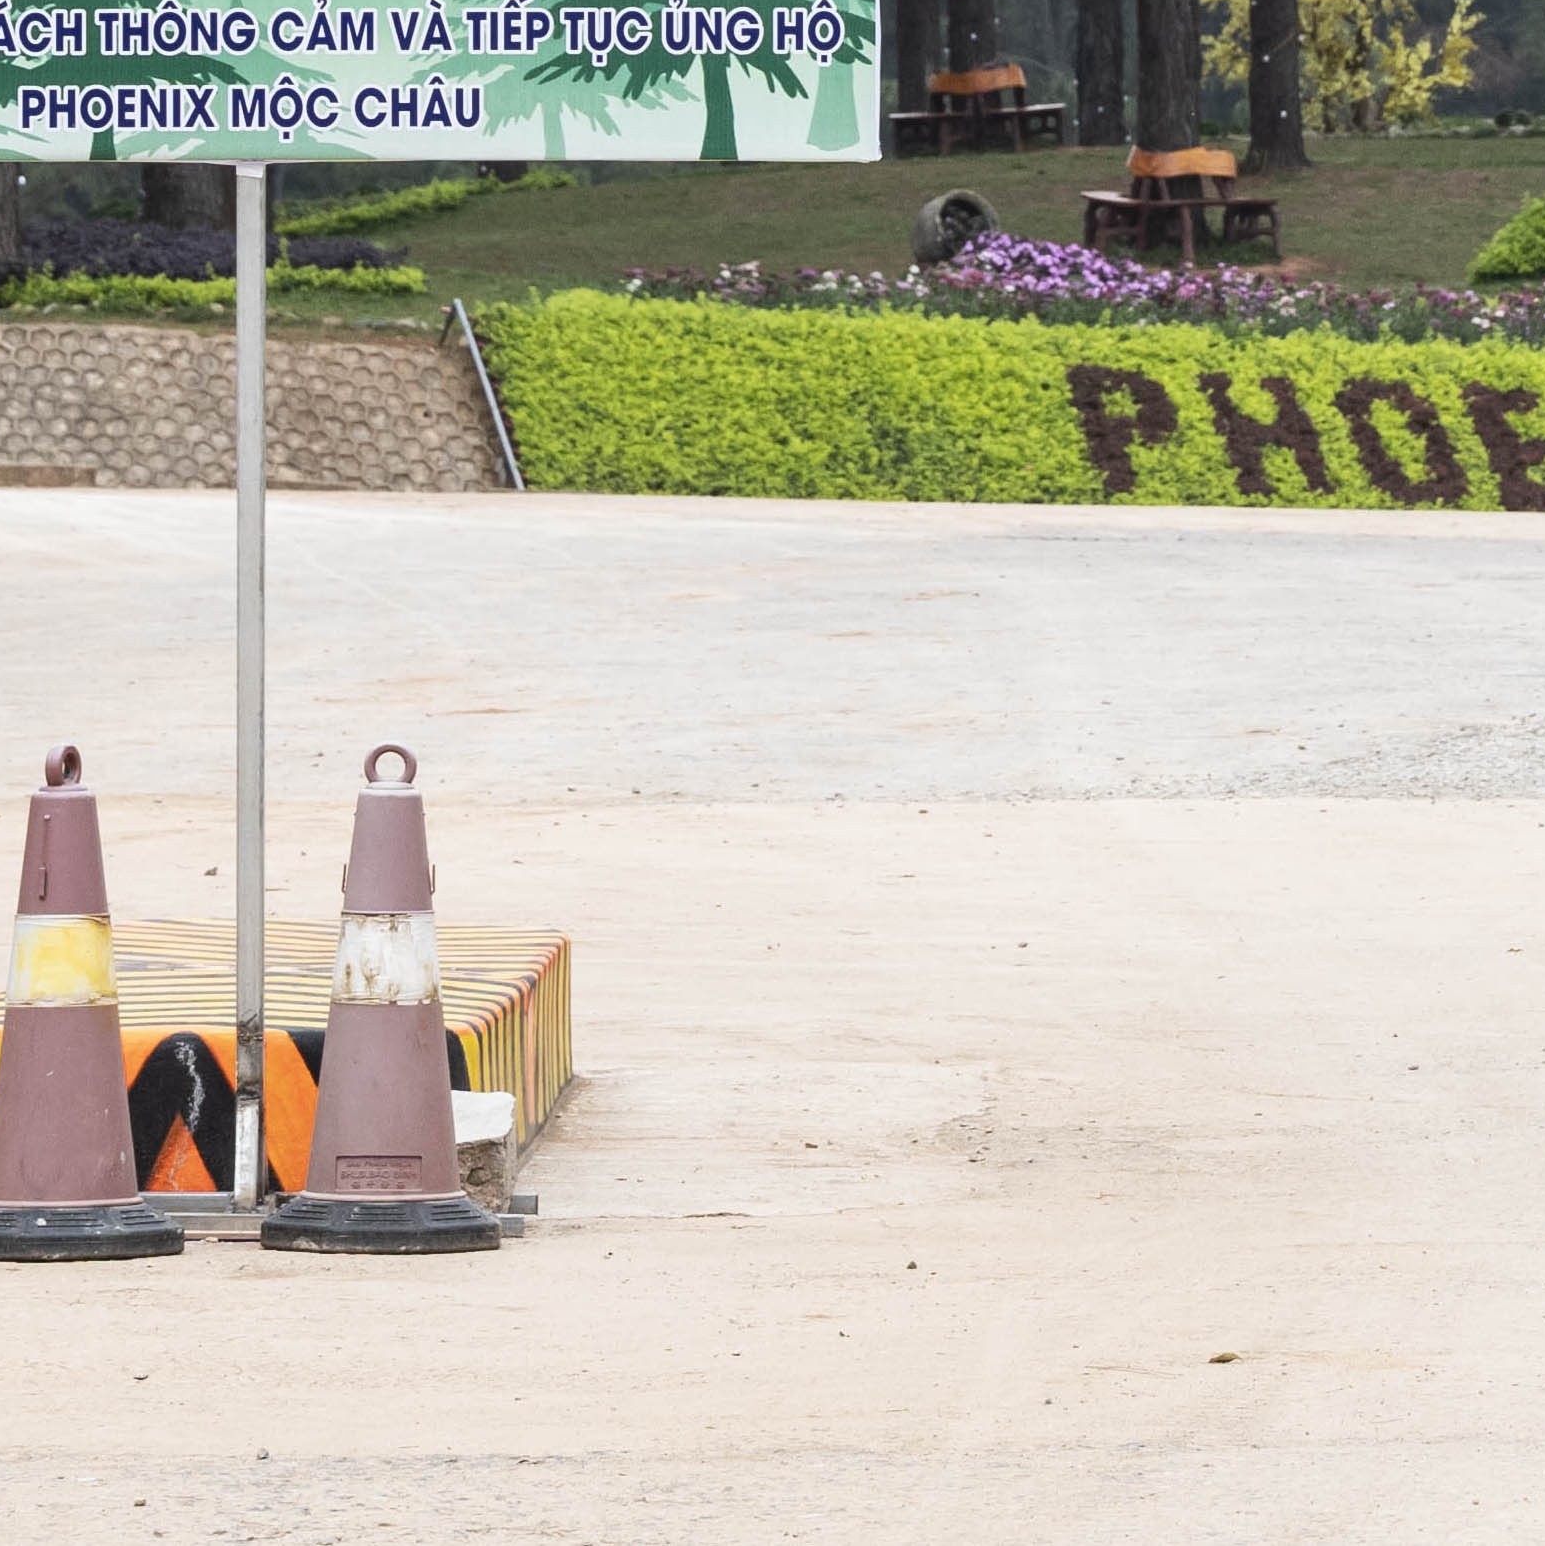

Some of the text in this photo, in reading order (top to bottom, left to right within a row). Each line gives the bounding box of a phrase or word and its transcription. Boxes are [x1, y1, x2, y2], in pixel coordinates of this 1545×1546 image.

[97, 0, 257, 53] THÔNG
[562, 9, 649, 64] TỤC
[21, 75, 481, 141] PHOENIX MỘC CHÂU
